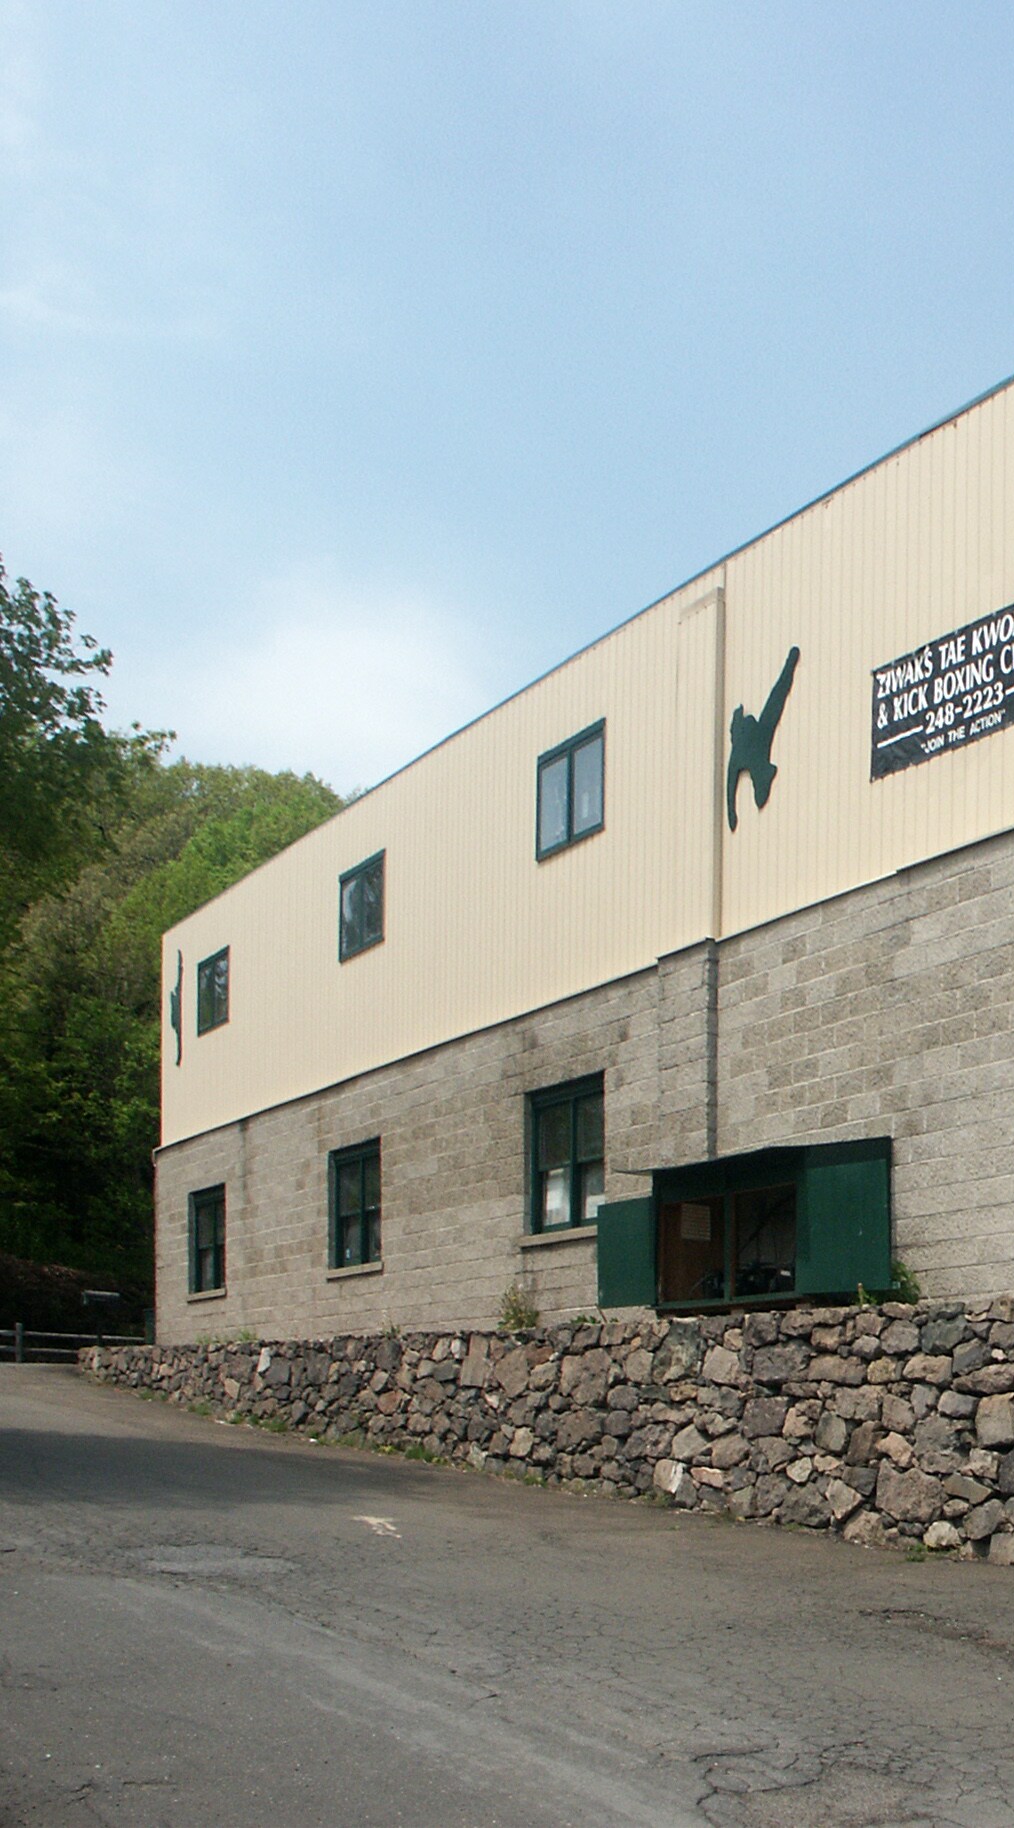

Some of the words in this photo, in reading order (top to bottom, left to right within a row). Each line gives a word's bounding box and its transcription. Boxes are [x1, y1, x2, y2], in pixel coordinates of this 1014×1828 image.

[939, 635, 966, 670] TAE
[877, 703, 888, 729] &
[893, 683, 929, 721] KICK
[934, 654, 994, 704] BOXING
[925, 682, 1004, 734] 248-2223
[948, 726, 965, 742] THE
